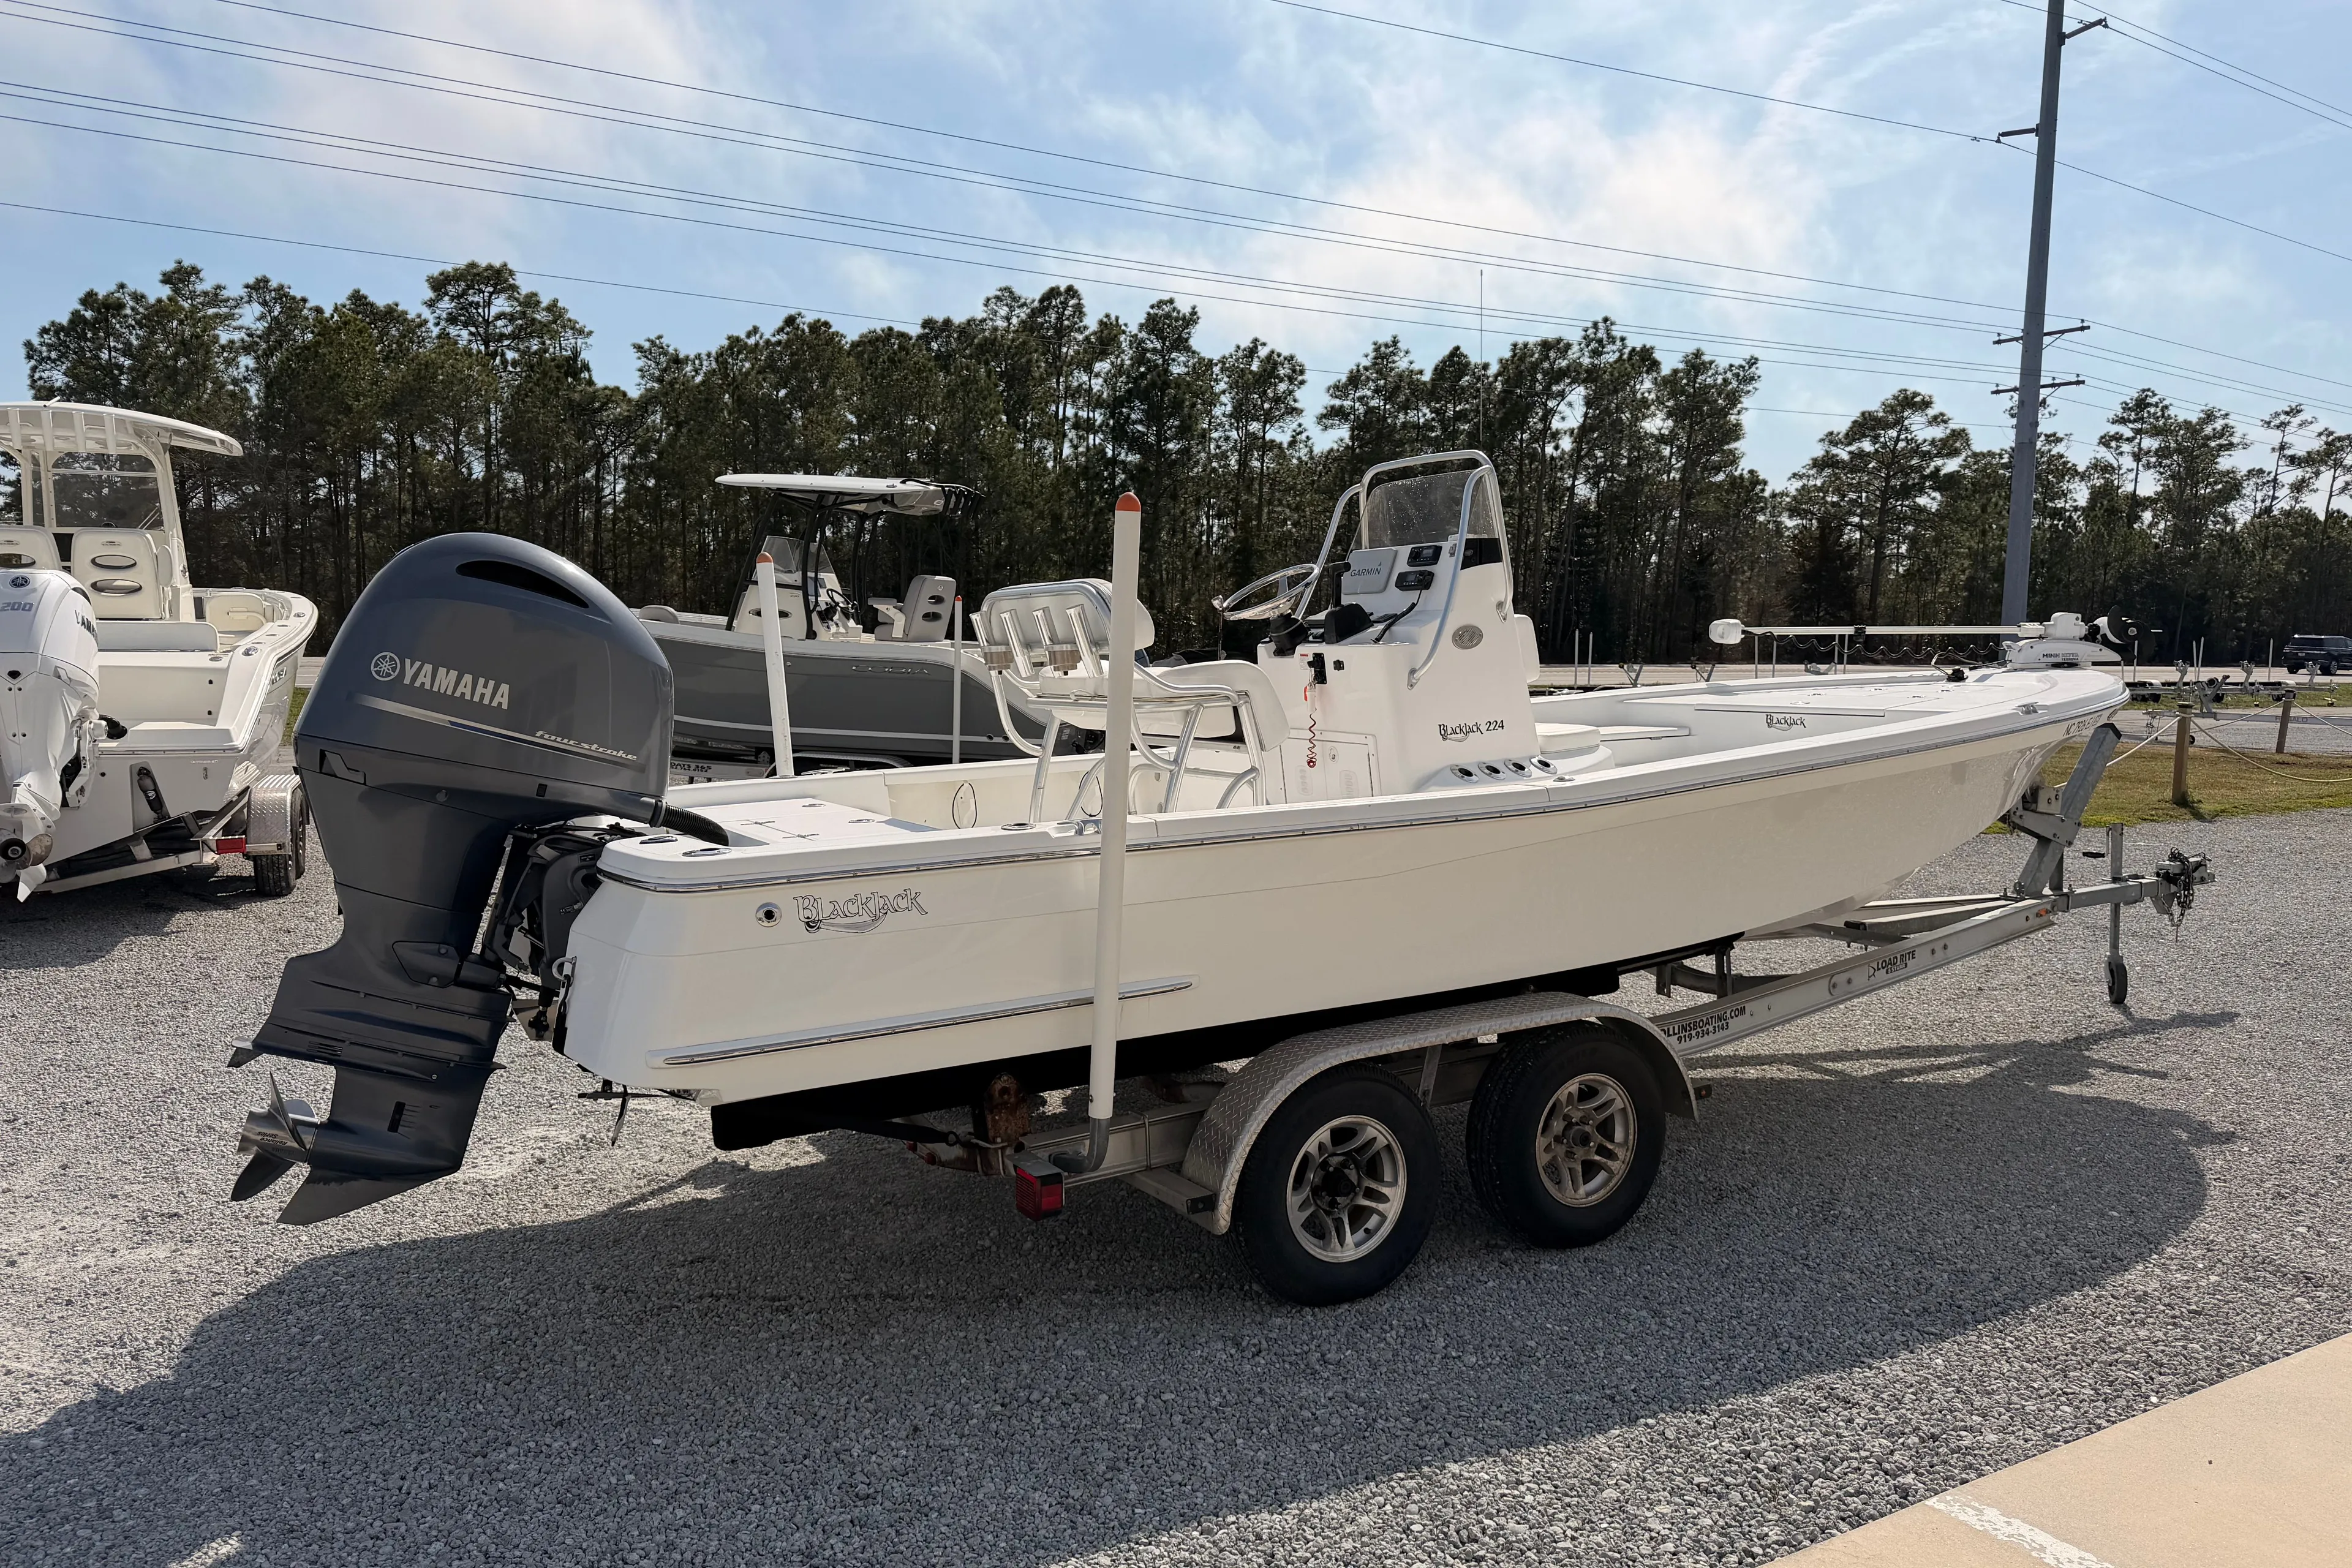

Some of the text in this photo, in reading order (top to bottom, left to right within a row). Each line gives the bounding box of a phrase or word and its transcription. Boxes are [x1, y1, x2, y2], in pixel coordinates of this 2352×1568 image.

[1351, 568, 1381, 577] GARMIN
[1, 601, 34, 612] 200
[852, 665, 931, 675] COBIA
[403, 658, 510, 710] YAMAHA
[1485, 719, 1505, 731] 224
[1877, 949, 1916, 971] LOAD RITE
[1660, 1005, 1746, 1038] OLLINSBOATING.COM
[1677, 1021, 1729, 1044] 919-934-3143
